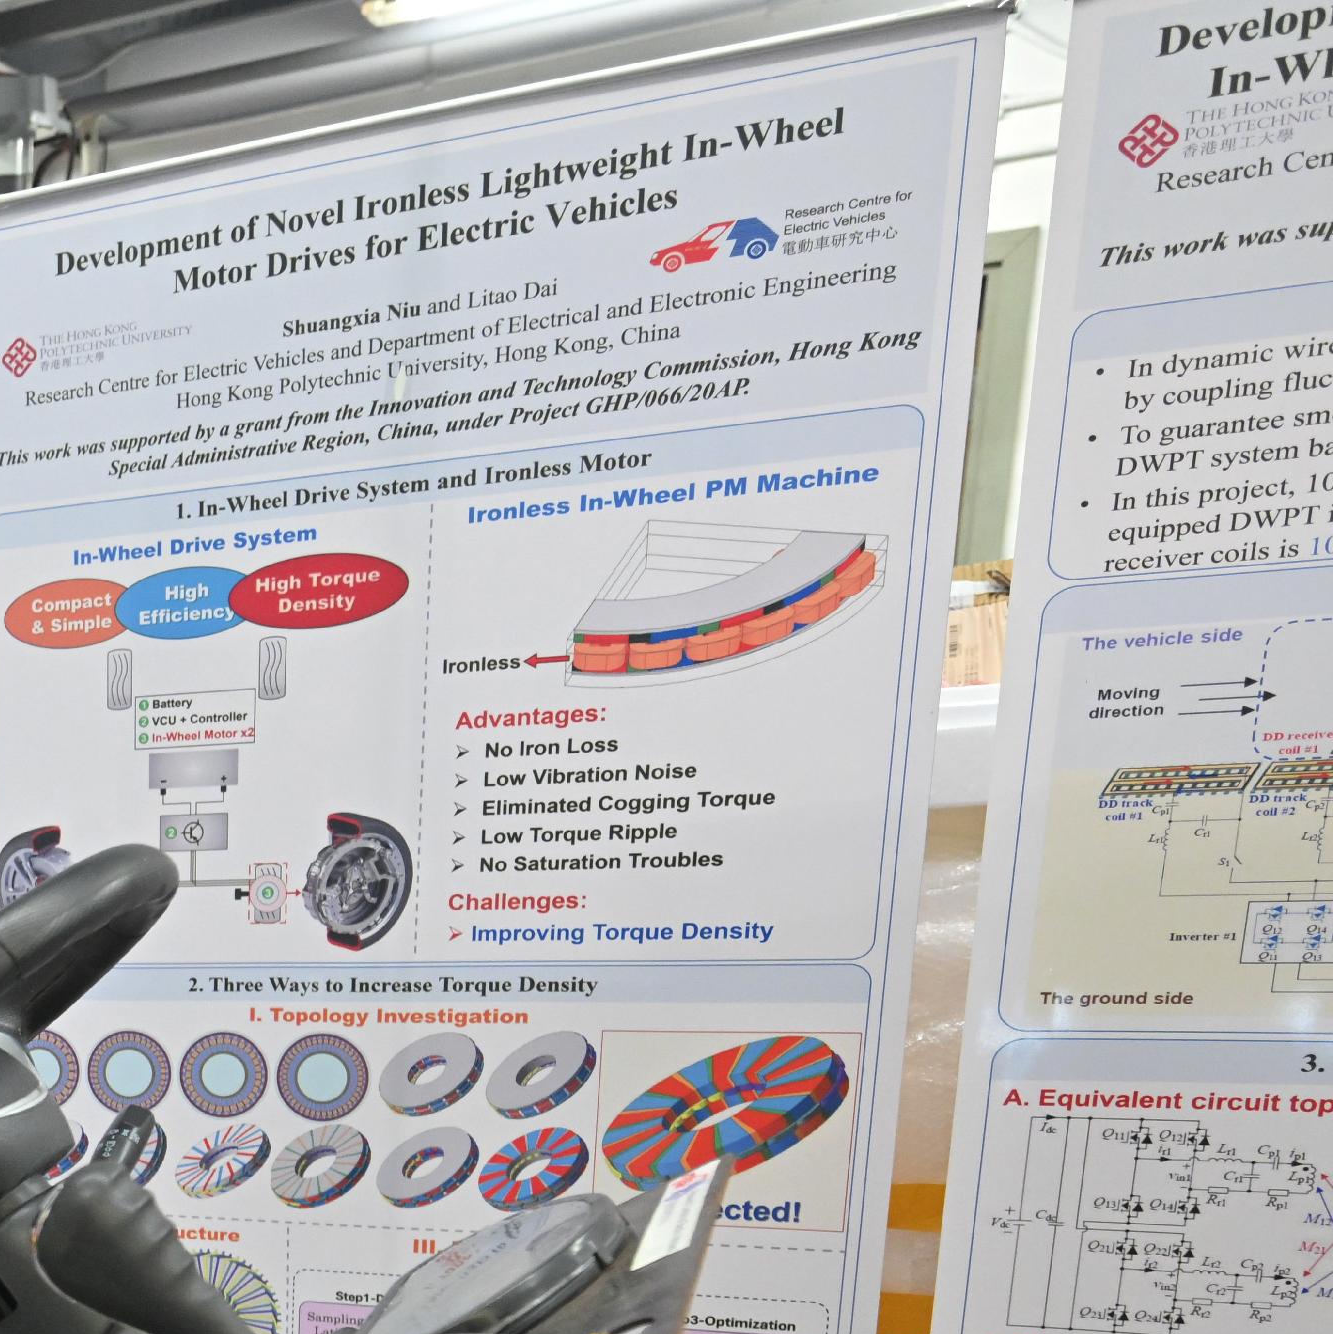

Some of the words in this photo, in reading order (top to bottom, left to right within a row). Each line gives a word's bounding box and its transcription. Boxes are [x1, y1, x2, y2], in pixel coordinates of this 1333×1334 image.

[1156, 7, 1333, 58] Develop
[56, 224, 222, 276] Development
[230, 215, 260, 243] of
[266, 199, 344, 237] Novel
[355, 183, 470, 221] Ironless
[480, 140, 673, 199] Lightweight
[683, 106, 844, 162] In-Wheel
[785, 201, 844, 220] Research
[848, 195, 892, 210] Centre
[895, 191, 913, 203] for
[783, 219, 830, 236] Electric
[833, 211, 886, 227] Vehicles
[173, 263, 258, 294] Motor
[267, 246, 355, 278] Drives
[365, 234, 408, 261] for
[417, 209, 535, 252] Electric
[546, 188, 678, 229] Vehicles
[468, 500, 570, 524] Ironless
[580, 482, 695, 513] In-Wheel
[706, 476, 747, 499] PM
[757, 466, 879, 494] Machine
[73, 540, 162, 566] In-Wheel
[170, 536, 226, 556] Drive
[233, 528, 317, 552] System
[165, 582, 209, 603] High
[255, 574, 301, 595] High
[308, 570, 381, 588] Torque
[31, 592, 112, 613] Compact
[278, 594, 355, 613] Density
[31, 619, 45, 635] &
[51, 614, 112, 633] Simple
[139, 605, 238, 626] Efficiency
[1082, 636, 1118, 651] The
[1124, 630, 1193, 649] vehicle
[1201, 627, 1243, 644] side
[443, 656, 521, 675] Ironless
[152, 699, 193, 710] Battery
[1097, 687, 1160, 701] Moving
[152, 715, 177, 727] VCU
[180, 716, 187, 724] +
[190, 711, 248, 724] Controller
[455, 707, 606, 730] Advantages:
[1088, 704, 1164, 720] direction
[152, 730, 201, 743] In-Wheel
[204, 729, 238, 740] Motor
[240, 727, 255, 738] x2
[485, 742, 513, 759] No
[520, 740, 560, 757] Iron
[567, 738, 618, 754] Loss
[484, 771, 527, 787] Low
[532, 766, 628, 785] Vibration
[635, 763, 697, 781] Noise
[482, 796, 592, 817] Eliminated
[598, 793, 690, 815] Cogging
[697, 791, 776, 811] Torque
[481, 829, 524, 845] Low
[529, 827, 602, 846] Torque
[609, 822, 678, 844] Ripple
[480, 857, 507, 873] No
[513, 854, 621, 872] Saturation
[628, 851, 724, 869] Troubles
[448, 892, 587, 914] Challenges:
[472, 924, 584, 946] Improving
[592, 923, 674, 945] Torque
[681, 921, 774, 944] Density
[188, 977, 204, 992] 2.
[208, 977, 263, 992] Three
[269, 977, 319, 997] Ways
[325, 979, 343, 993] to
[350, 977, 433, 993] Increase
[438, 976, 512, 997] Torque
[519, 976, 598, 997] Density
[1040, 991, 1074, 1005] The
[1079, 991, 1148, 1008] ground
[1153, 991, 1194, 1005] side
[249, 1007, 262, 1022] I.
[269, 1007, 369, 1028] Topology
[377, 1007, 529, 1028] Investigation
[1002, 1088, 1029, 1107] A.
[1039, 1088, 1183, 1112] Equivalent
[1191, 1092, 1281, 1112] circuit
